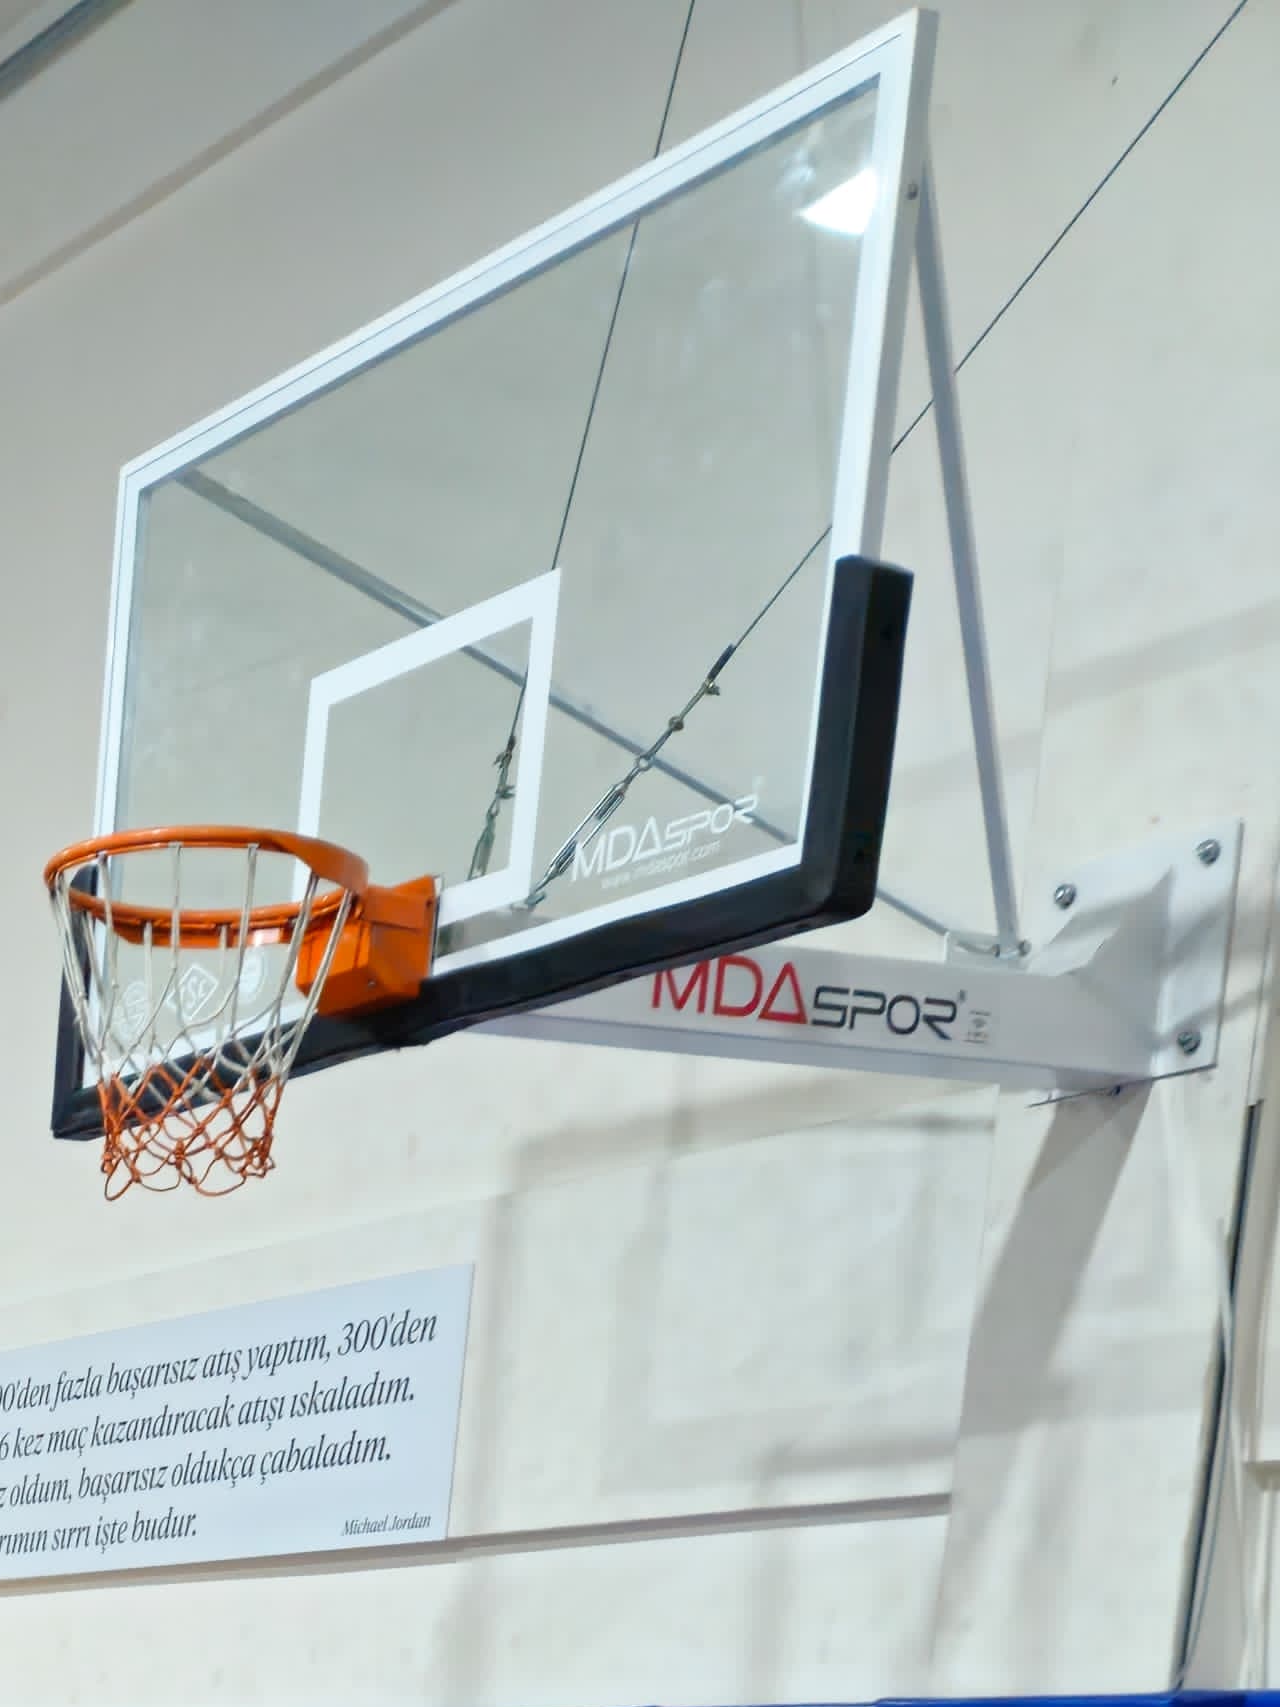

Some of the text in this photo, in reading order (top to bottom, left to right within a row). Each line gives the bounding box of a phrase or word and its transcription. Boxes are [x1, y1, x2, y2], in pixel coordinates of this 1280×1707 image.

[570, 793, 758, 883] MDASPOR
[651, 955, 958, 1041] MDASPOR
[50, 1366, 103, 1413] fazla
[106, 1357, 199, 1399] başarısız
[202, 1348, 242, 1383] atış
[240, 1333, 331, 1381] yaptım,
[337, 1309, 437, 1356] 300'den
[12, 1427, 44, 1460] kez
[46, 1426, 89, 1458] maç
[90, 1395, 233, 1447] kazandıracak
[237, 1396, 285, 1431] atışı
[289, 1371, 415, 1418] ıskaladım.
[9, 1473, 73, 1507] oldum,
[78, 1465, 169, 1504] başarısız
[171, 1448, 256, 1490] oldukça
[259, 1430, 392, 1485] çabaladım.
[51, 1522, 91, 1553] sırrı
[94, 1516, 127, 1554] işte
[131, 1506, 198, 1543] budur.
[340, 1513, 432, 1537] Michael Jordan
